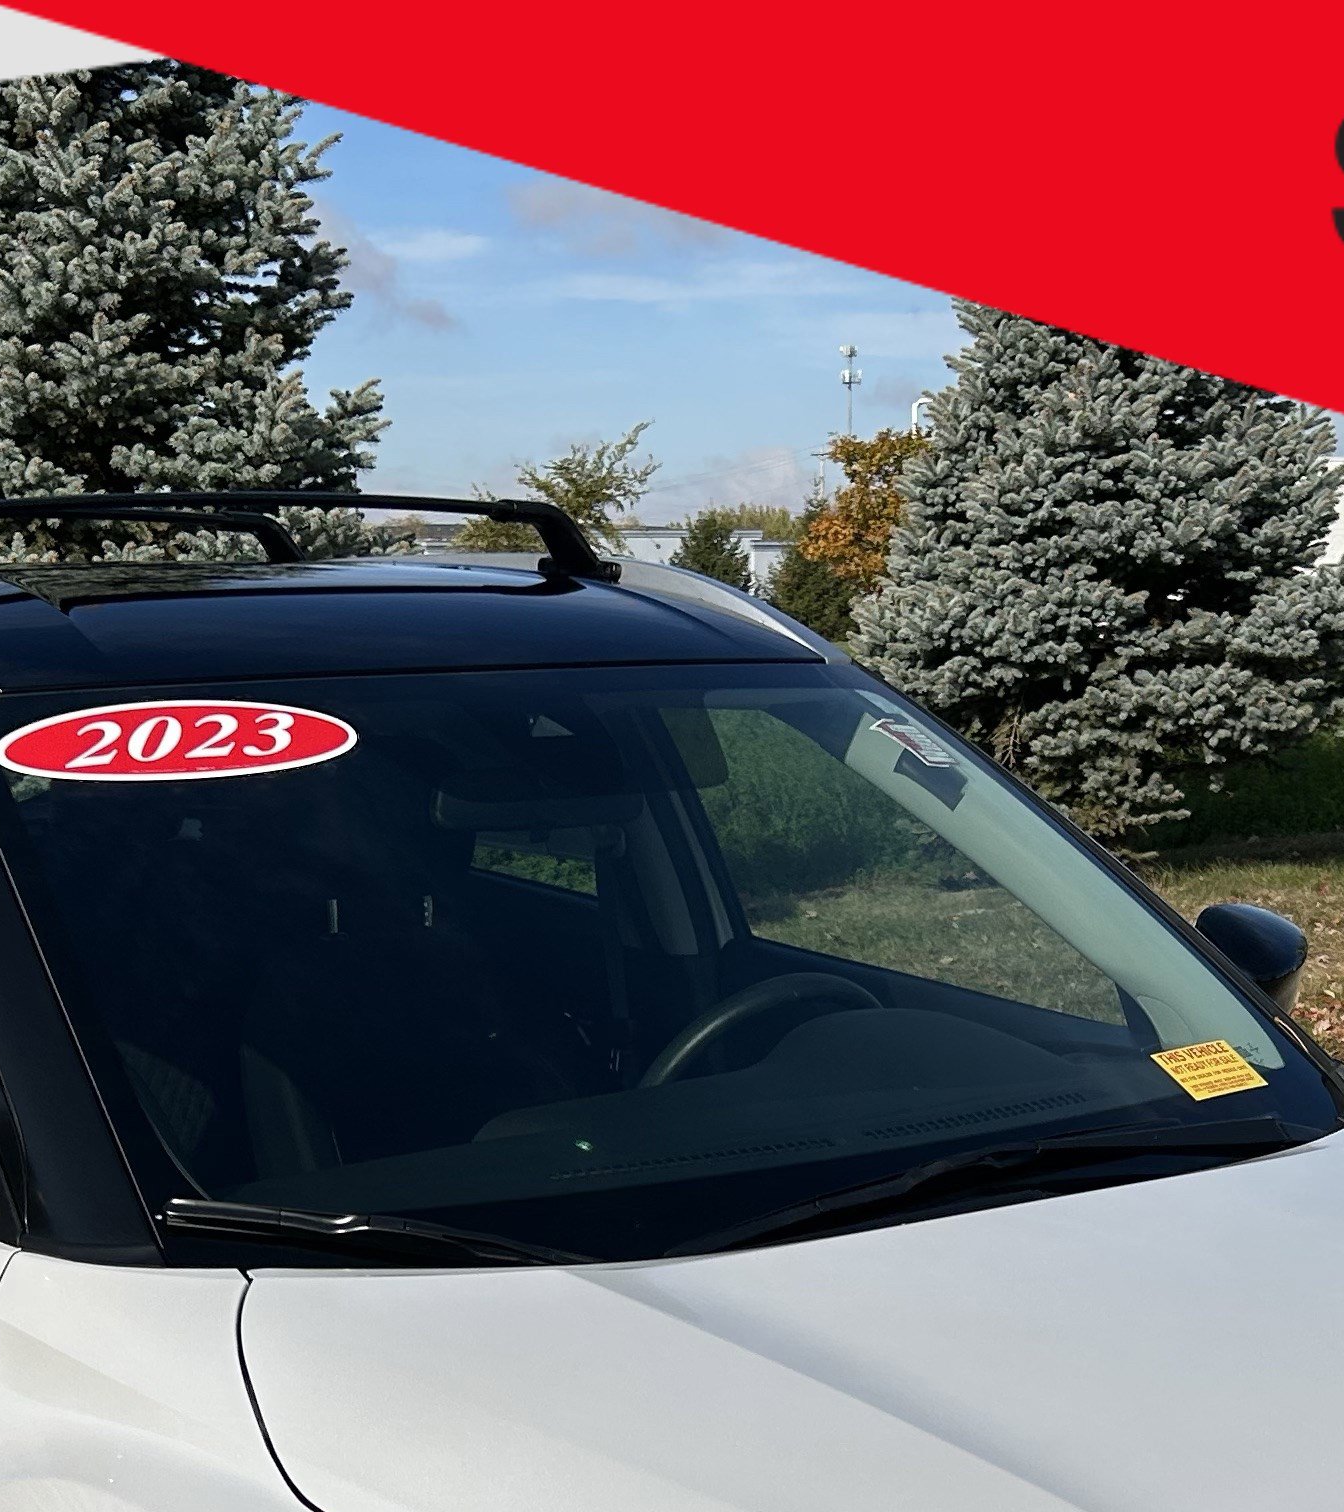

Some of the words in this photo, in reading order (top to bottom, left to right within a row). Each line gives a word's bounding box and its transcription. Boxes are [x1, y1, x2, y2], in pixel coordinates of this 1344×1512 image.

[64, 711, 296, 769] 2023
[1157, 1050, 1187, 1066] THIS
[1182, 1042, 1230, 1060] VEHICLE
[1170, 1064, 1188, 1075] NOT
